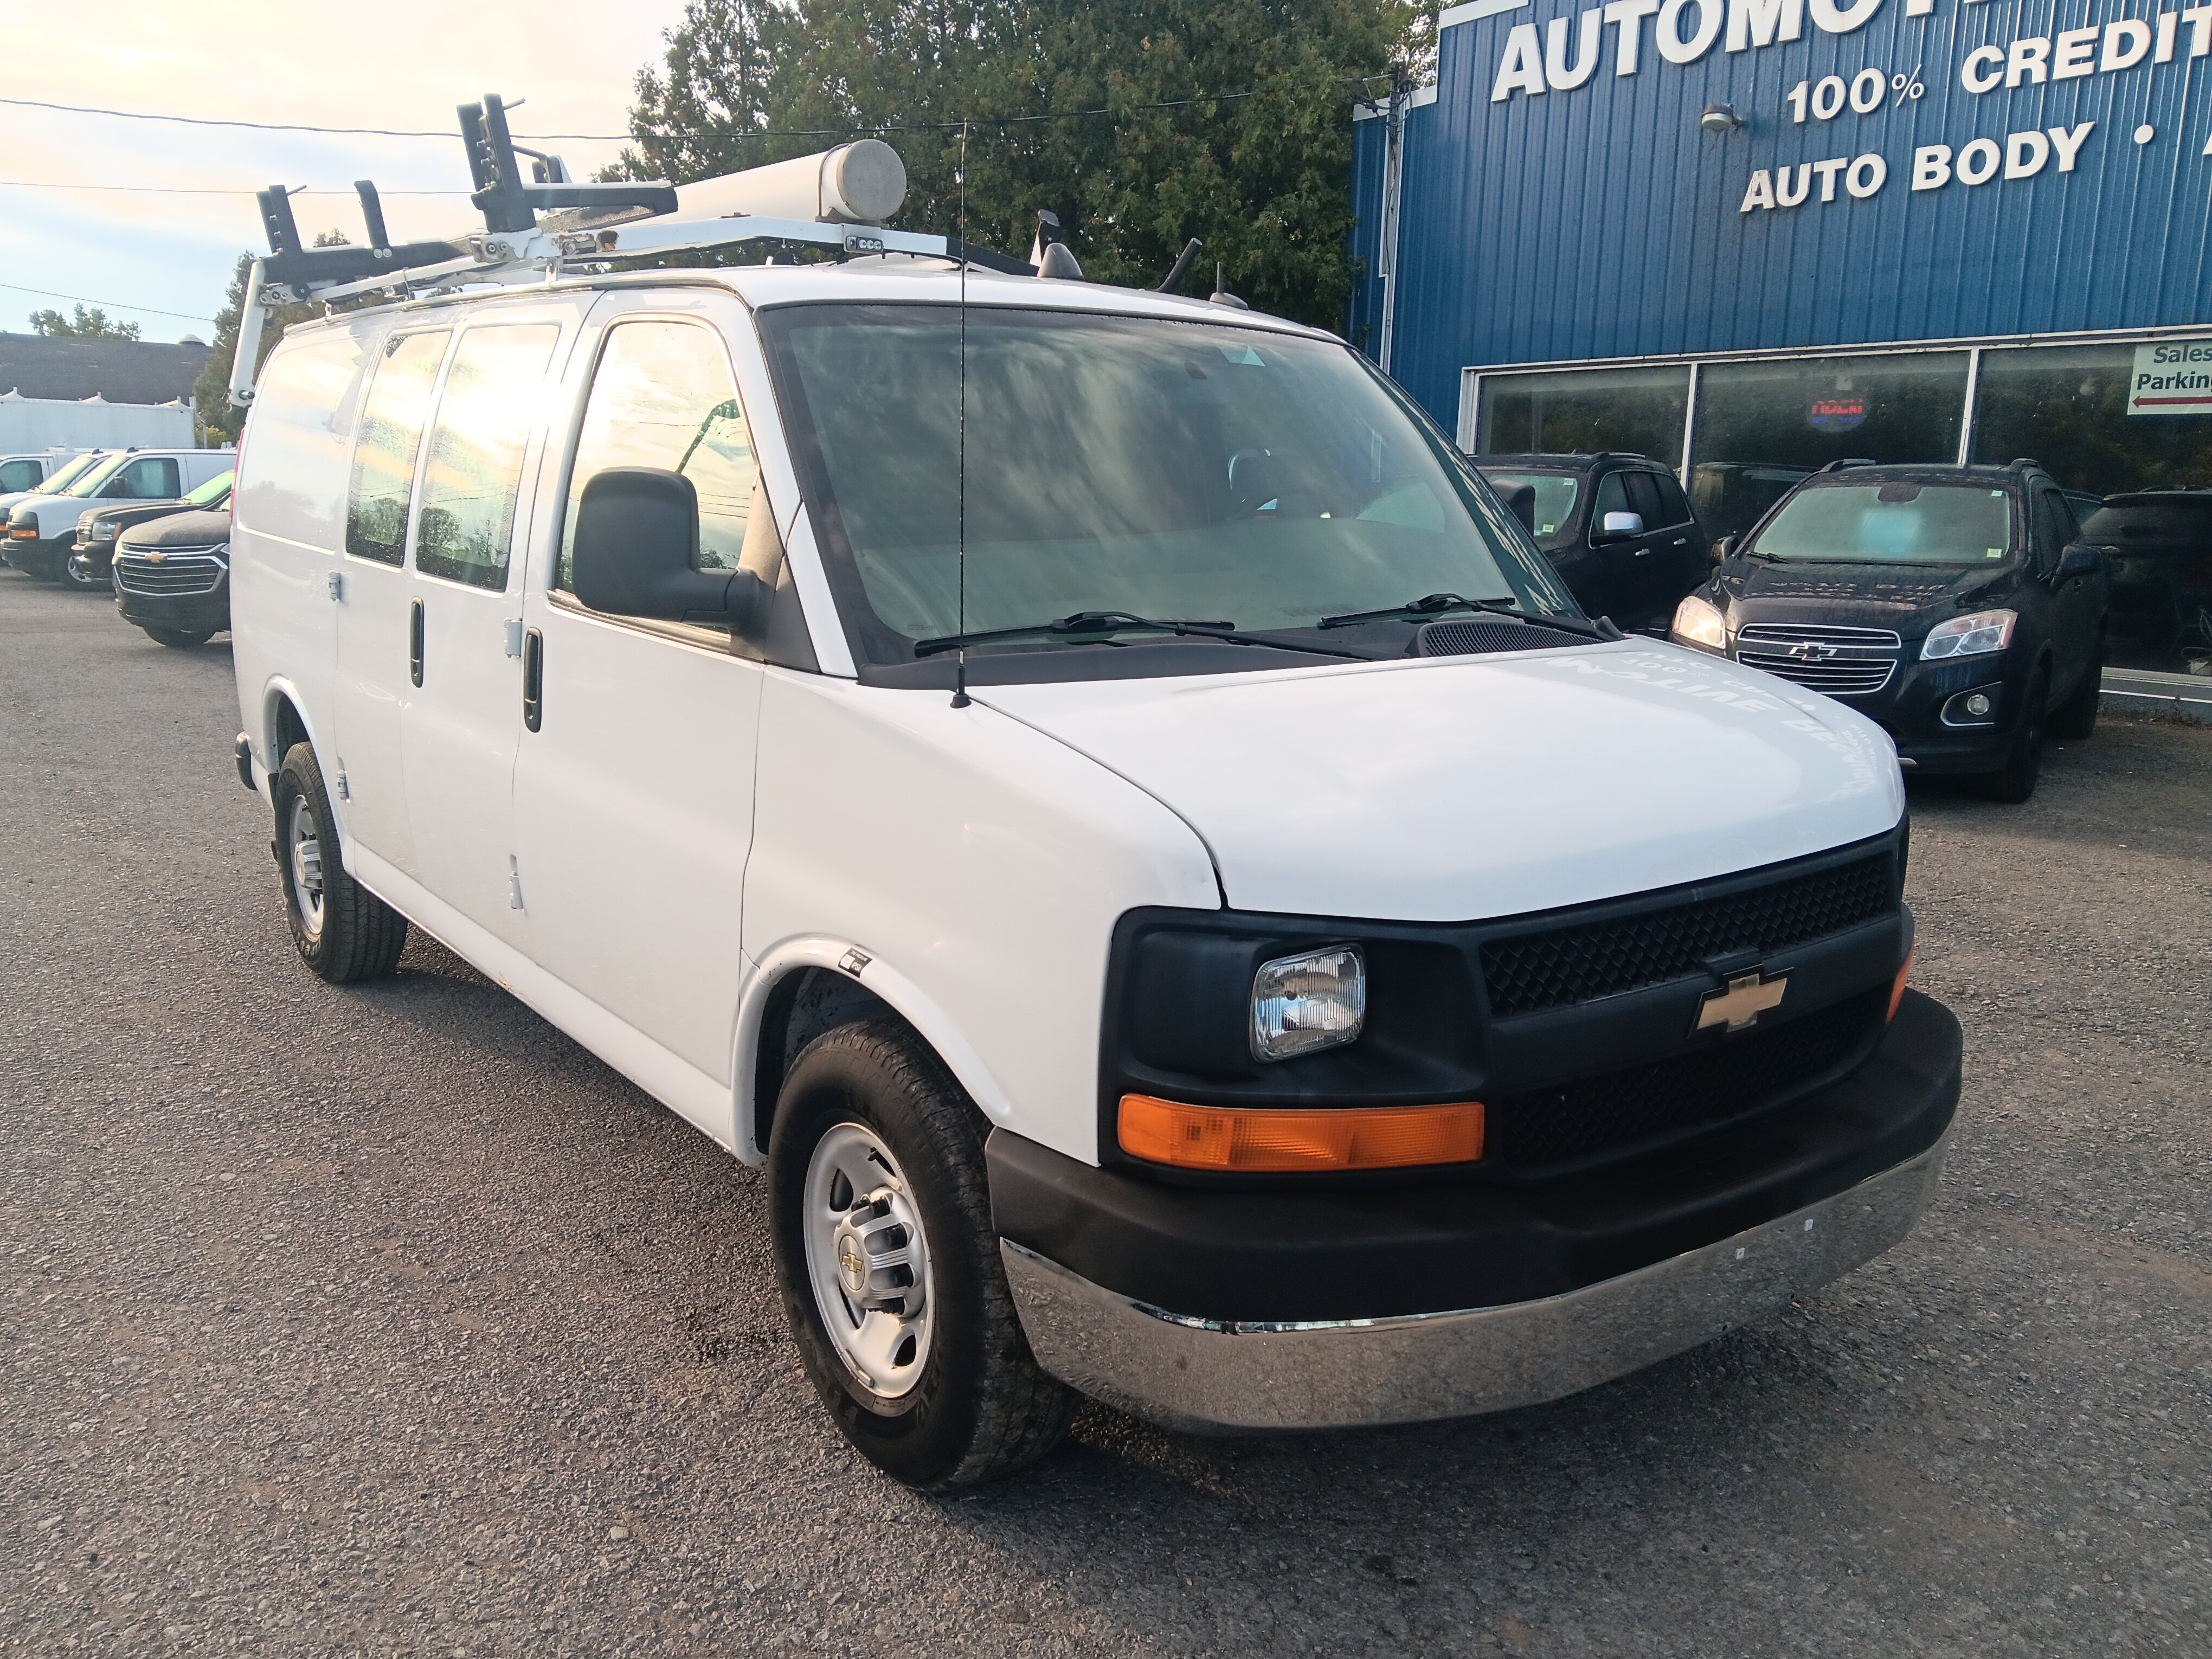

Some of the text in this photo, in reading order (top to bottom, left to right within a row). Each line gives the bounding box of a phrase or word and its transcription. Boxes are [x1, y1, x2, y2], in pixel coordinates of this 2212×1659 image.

[1787, 5, 2212, 123] 100% CREDIT
[1740, 121, 2096, 212] AUTO BODY
[2137, 371, 2212, 392] Parkin
[2153, 344, 2212, 363] Sales
